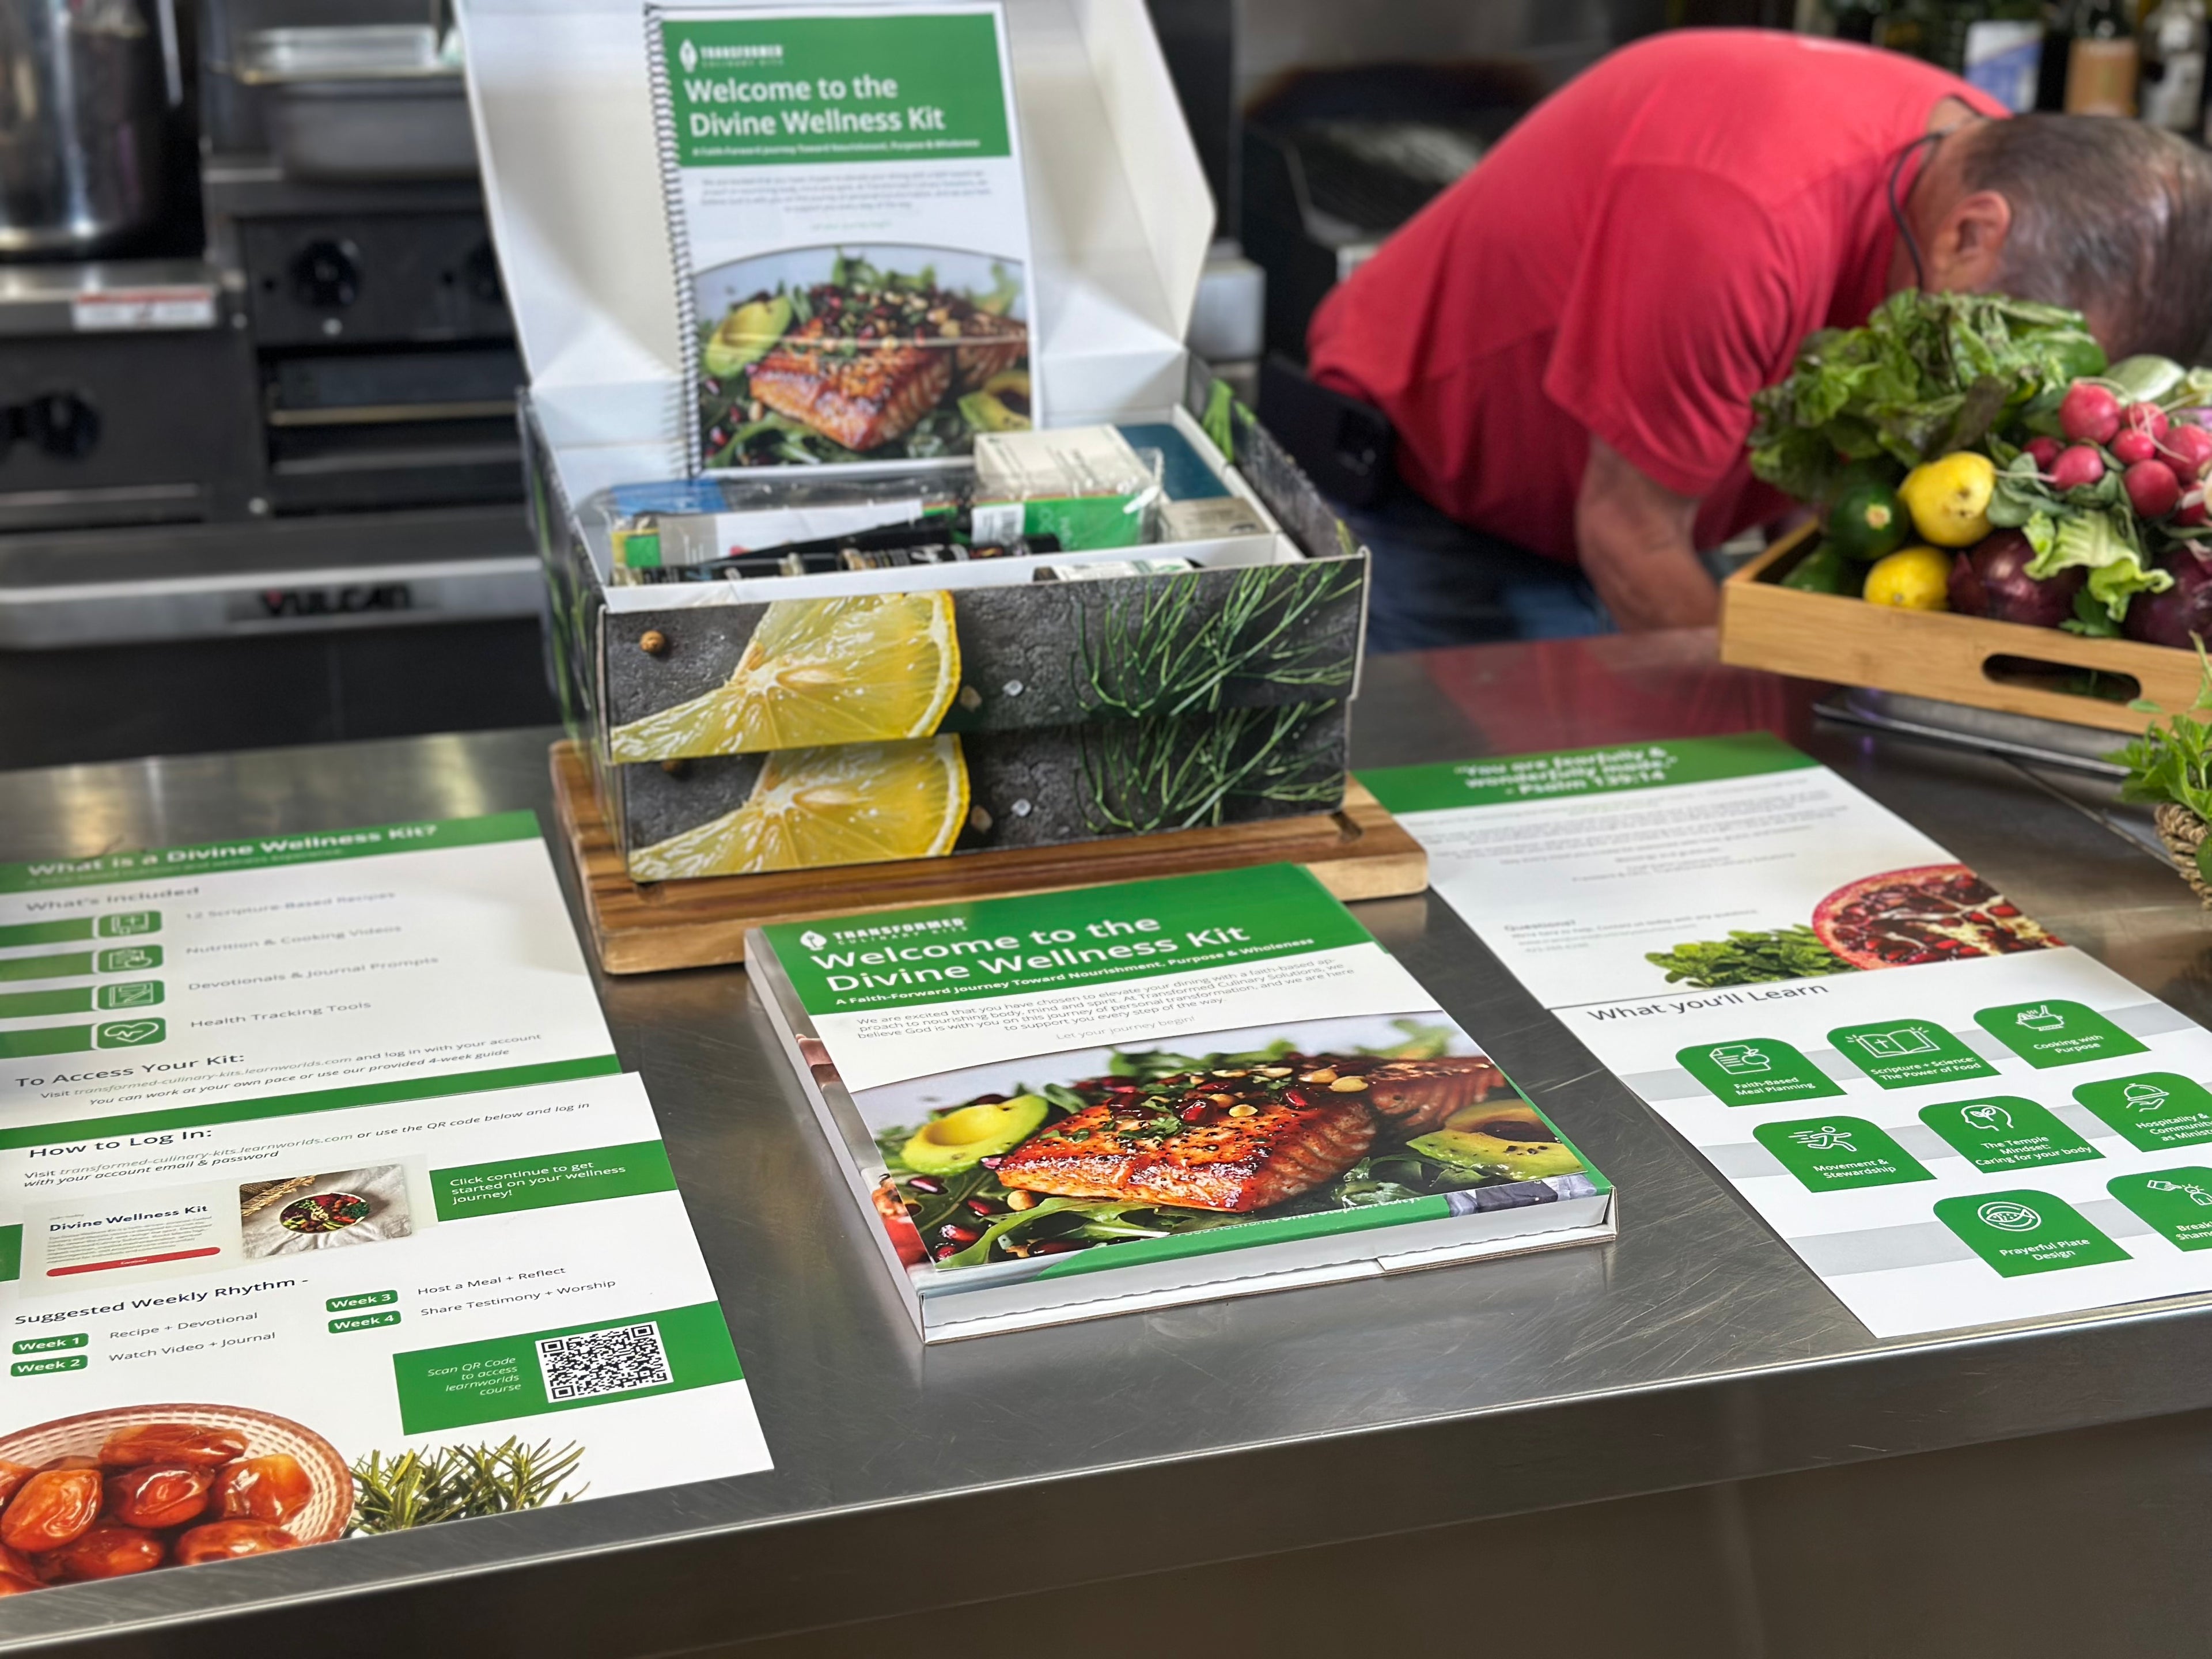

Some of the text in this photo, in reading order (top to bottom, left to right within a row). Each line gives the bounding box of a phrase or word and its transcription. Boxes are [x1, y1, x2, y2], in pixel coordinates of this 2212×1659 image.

[684, 75, 897, 103] Welcome to the
[690, 108, 945, 137] Divine Wellness Kit
[28, 860, 101, 876] What
[112, 858, 133, 868] is
[142, 855, 158, 865] a
[167, 846, 253, 862] Divine
[260, 832, 381, 853] Wellness
[388, 824, 437, 839] Kit?
[832, 918, 965, 940] TRANSFORMED
[810, 918, 1161, 970] Welcome to the
[825, 926, 1251, 992] Divine Wellness Kit
[849, 987, 951, 1003] Faith-Forward
[953, 982, 1009, 994] Journey
[1011, 974, 1066, 986] Toward
[1167, 953, 1225, 965] Purpose
[1238, 938, 1314, 955] Wholeness
[1587, 986, 1828, 1020] What you'll Learn
[191, 1002, 371, 1027] Health Tracking Tools
[1078, 1030, 1104, 1038] your
[1110, 1022, 1154, 1034] journey
[1158, 1016, 1194, 1025] begin!
[2033, 1039, 2080, 1050] Cooking
[2054, 1042, 2100, 1053] Purpose
[15, 1055, 244, 1087] To Access Your Kit:
[75, 1058, 351, 1094] transformed-culinary-kits.learnworlds.com
[356, 1053, 381, 1061] and
[456, 1041, 484, 1050] your
[490, 1035, 540, 1044] account
[1869, 1064, 1923, 1074] Scripture
[1931, 1057, 1975, 1067] Science:
[1902, 1069, 1942, 1078] Power
[1952, 1062, 1983, 1071] Food
[1733, 1077, 1799, 1089] Faith-Based
[1764, 1083, 1816, 1092] Planning
[2135, 1115, 2197, 1128] Hospitality
[25, 1171, 55, 1179] Visit
[59, 1136, 353, 1175] transformed-culinary-kits.learnworlds.com
[427, 1122, 446, 1132] QR
[449, 1118, 480, 1127] code
[484, 1112, 523, 1122] below
[526, 1107, 552, 1116] and
[29, 1129, 211, 1158] How to Log In:
[1999, 1144, 2051, 1154] Mindset:
[2004, 1137, 2049, 1146] Temple
[1975, 1157, 2016, 1165] Caring
[2034, 1150, 2065, 1160] your
[2061, 1146, 2092, 1154] body
[24, 1179, 54, 1187] with
[56, 1175, 91, 1185] your
[94, 1167, 150, 1179] account
[155, 1161, 194, 1171] email
[211, 1150, 279, 1166] password
[449, 1176, 483, 1186] Click
[487, 1168, 549, 1181] continue
[571, 1162, 594, 1172] get
[1812, 1160, 1877, 1172] Movement
[1823, 1166, 1896, 1178] Stewardship
[452, 1181, 502, 1195] started
[528, 1175, 562, 1186] your
[565, 1167, 626, 1179] wellness
[453, 1189, 512, 1205] journey!
[50, 1206, 207, 1232] Divine Wellness Kit
[1999, 1239, 2090, 1256] Prayerful Plate
[2031, 1249, 2076, 1260] Design
[418, 1285, 450, 1294] Host
[468, 1277, 501, 1287] Meal
[518, 1268, 565, 1279] Reflect
[15, 1302, 124, 1324] Suggested
[131, 1292, 207, 1308] Weekly
[215, 1280, 294, 1297] Rhythm
[331, 1294, 392, 1309] Week 3
[421, 1305, 462, 1316] Share
[466, 1293, 540, 1308] Testimony
[556, 1281, 615, 1294] Worship
[110, 1328, 159, 1338] Recipe
[178, 1312, 257, 1330] Devotional
[334, 1315, 394, 1329] Week 4
[18, 1338, 66, 1351] Week
[109, 1350, 156, 1361] Watch
[161, 1344, 204, 1354] Video
[221, 1332, 275, 1347] Journal
[17, 1358, 81, 1373] Week 2
[428, 1357, 516, 1376] Scan QR Code
[478, 1366, 517, 1377] access
[445, 1374, 519, 1391] learnworlds
[480, 1384, 521, 1395] course
